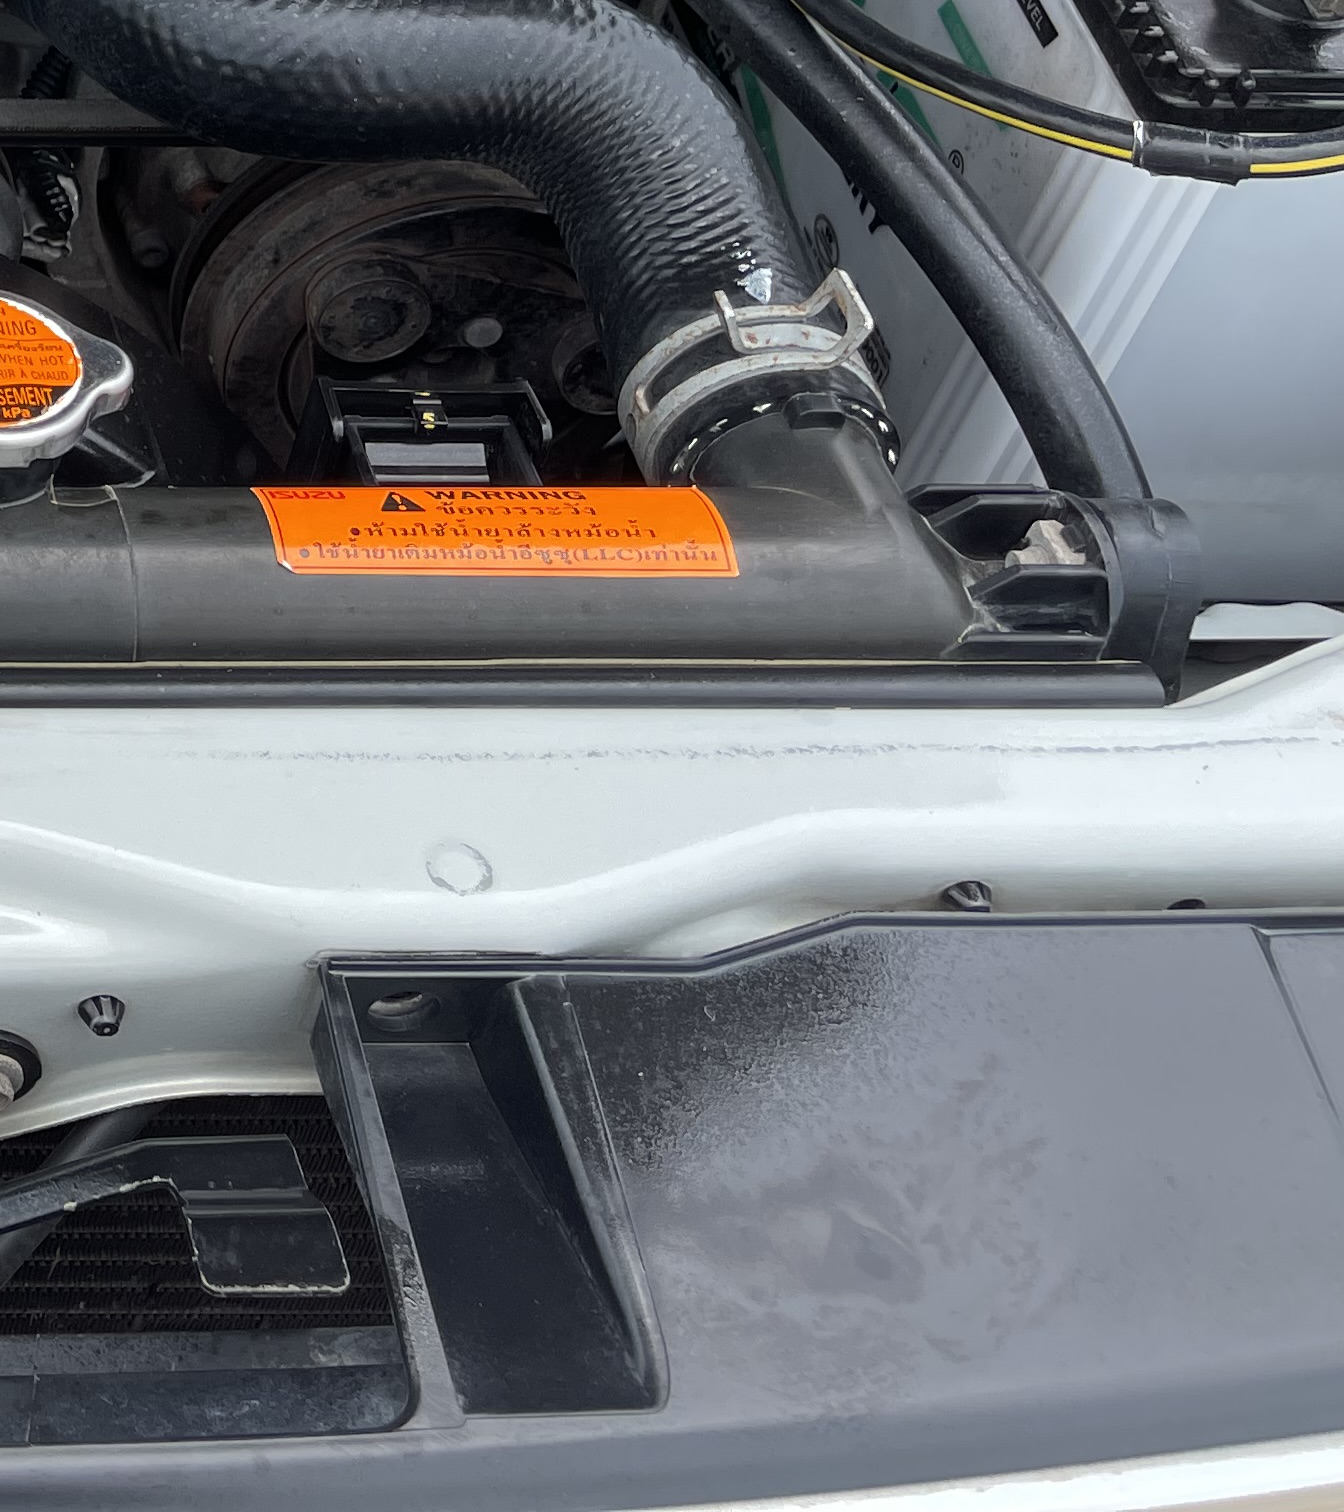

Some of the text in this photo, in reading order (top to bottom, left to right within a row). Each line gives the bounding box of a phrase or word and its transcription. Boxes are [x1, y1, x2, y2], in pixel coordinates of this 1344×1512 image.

[30, 369, 69, 382] CHAUD
[1, 406, 32, 420] kPa
[268, 490, 347, 501] ISUZU
[424, 489, 588, 502] WARNING
[435, 501, 598, 518] ข้อควรระวัง
